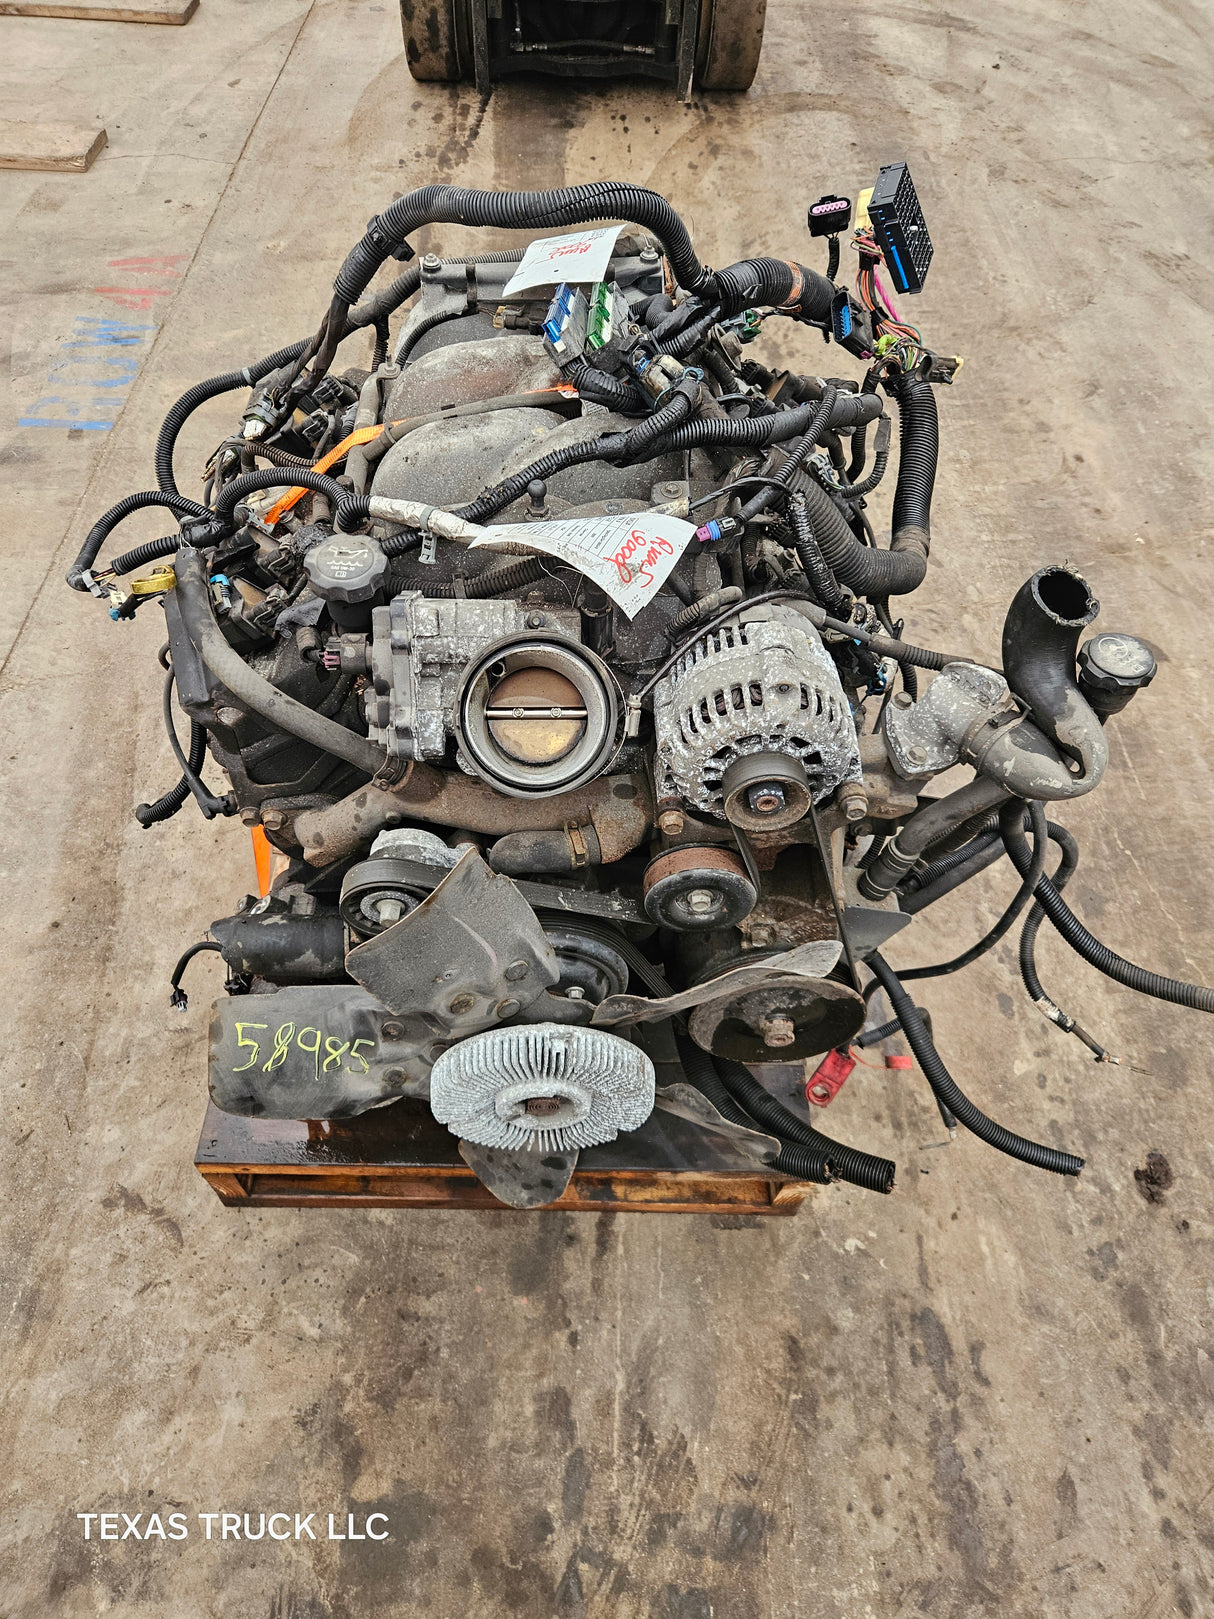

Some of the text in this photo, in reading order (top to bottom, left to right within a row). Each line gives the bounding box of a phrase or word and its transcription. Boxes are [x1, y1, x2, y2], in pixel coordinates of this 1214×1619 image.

[18, 316, 157, 431] ROW
[603, 529, 647, 584] good
[233, 1022, 375, 1081] 58985
